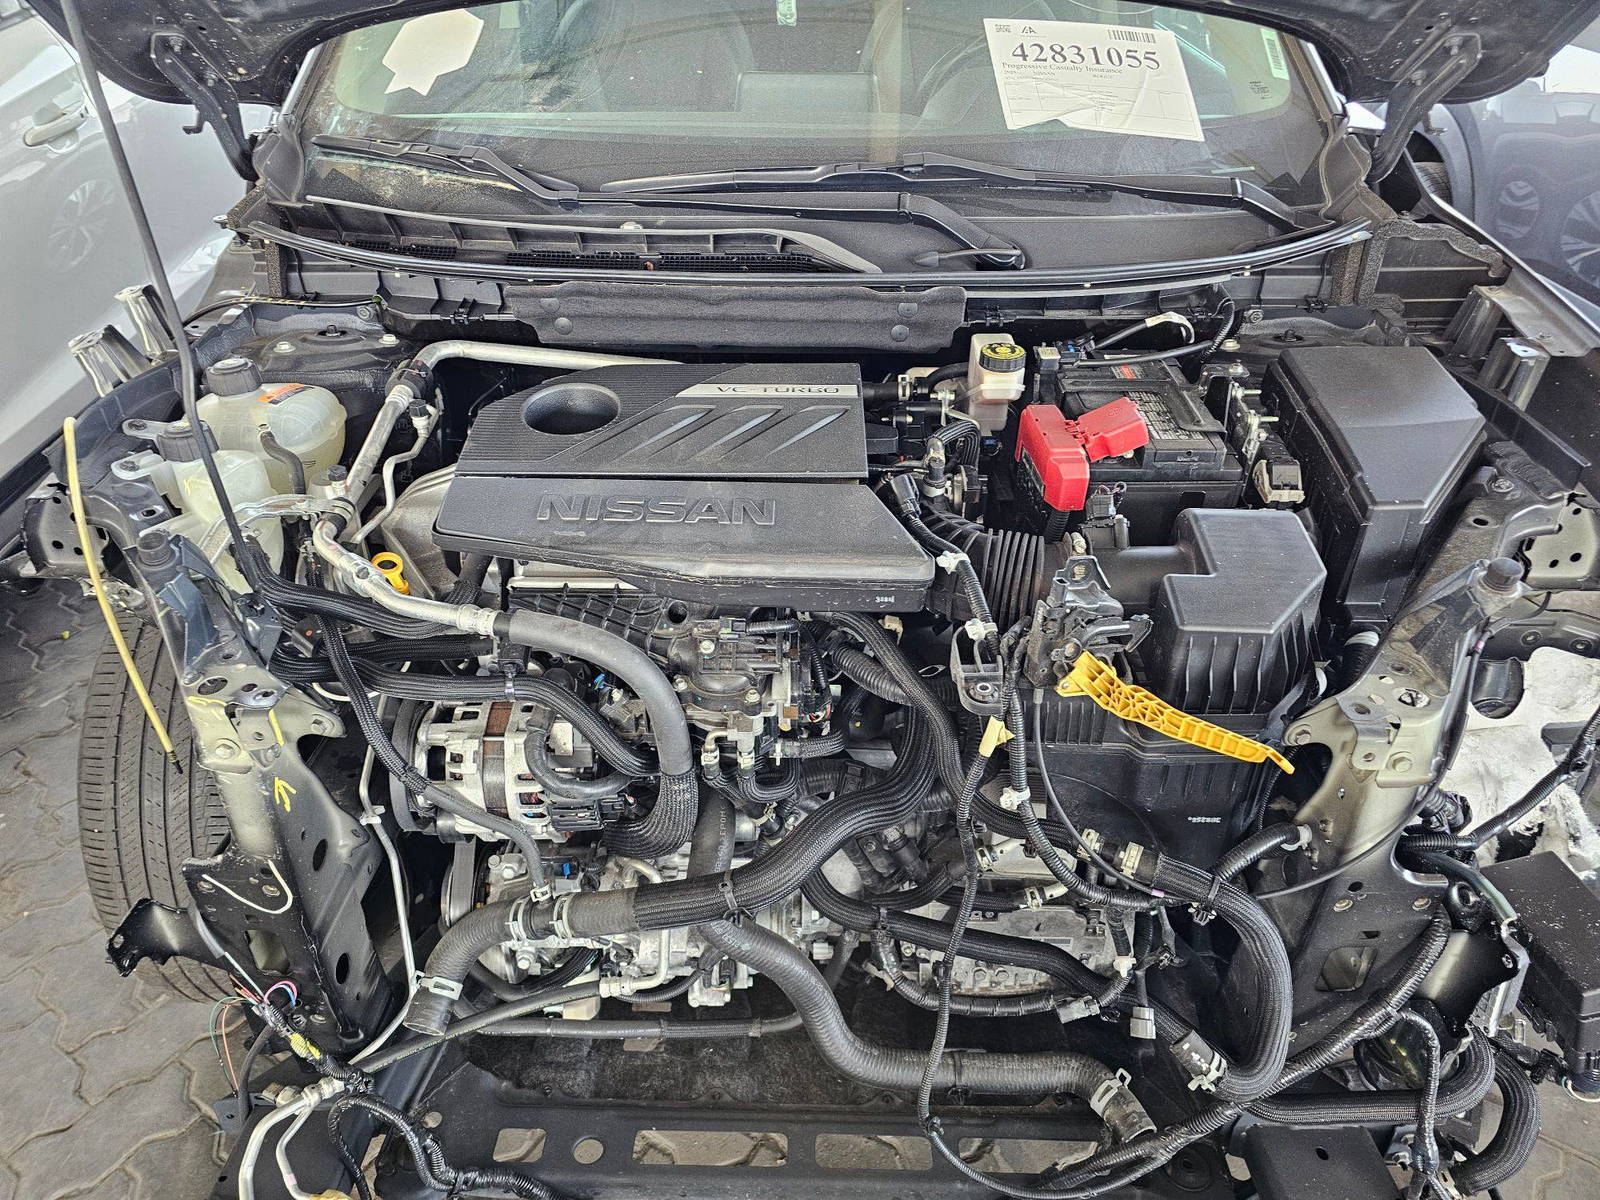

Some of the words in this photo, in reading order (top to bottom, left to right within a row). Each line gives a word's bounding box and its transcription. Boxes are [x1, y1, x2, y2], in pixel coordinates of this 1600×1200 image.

[1011, 42, 1160, 70] 42831055
[1002, 62, 1049, 70] Progressive
[1049, 64, 1083, 72] Casualty
[1085, 66, 1123, 74] Insurance
[716, 385, 840, 394] VC-TURBO
[536, 494, 776, 525] NISSAN
